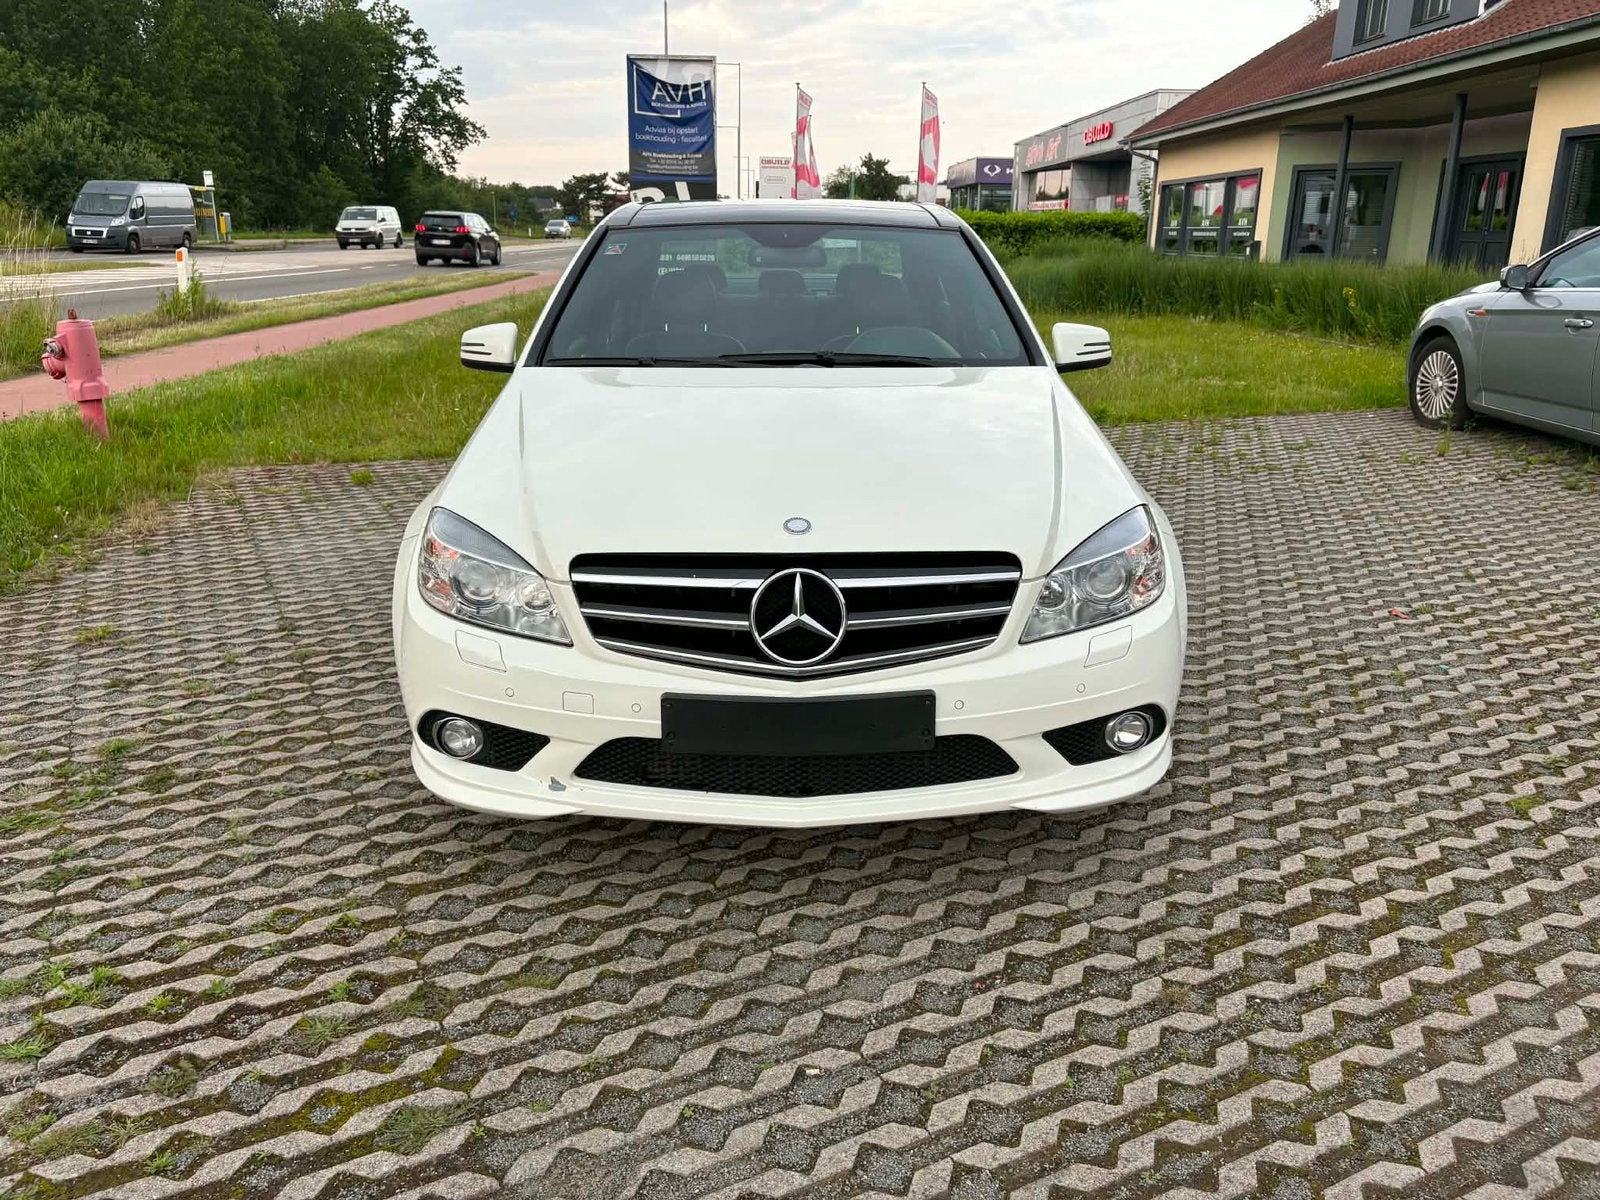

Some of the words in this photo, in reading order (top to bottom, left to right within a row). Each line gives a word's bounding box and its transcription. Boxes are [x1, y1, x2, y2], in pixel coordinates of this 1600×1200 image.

[652, 81, 706, 102] AVH
[645, 125, 666, 133] Advies
[667, 126, 676, 136] bij
[676, 126, 698, 135] opstart
[635, 132, 676, 144] boekhouding
